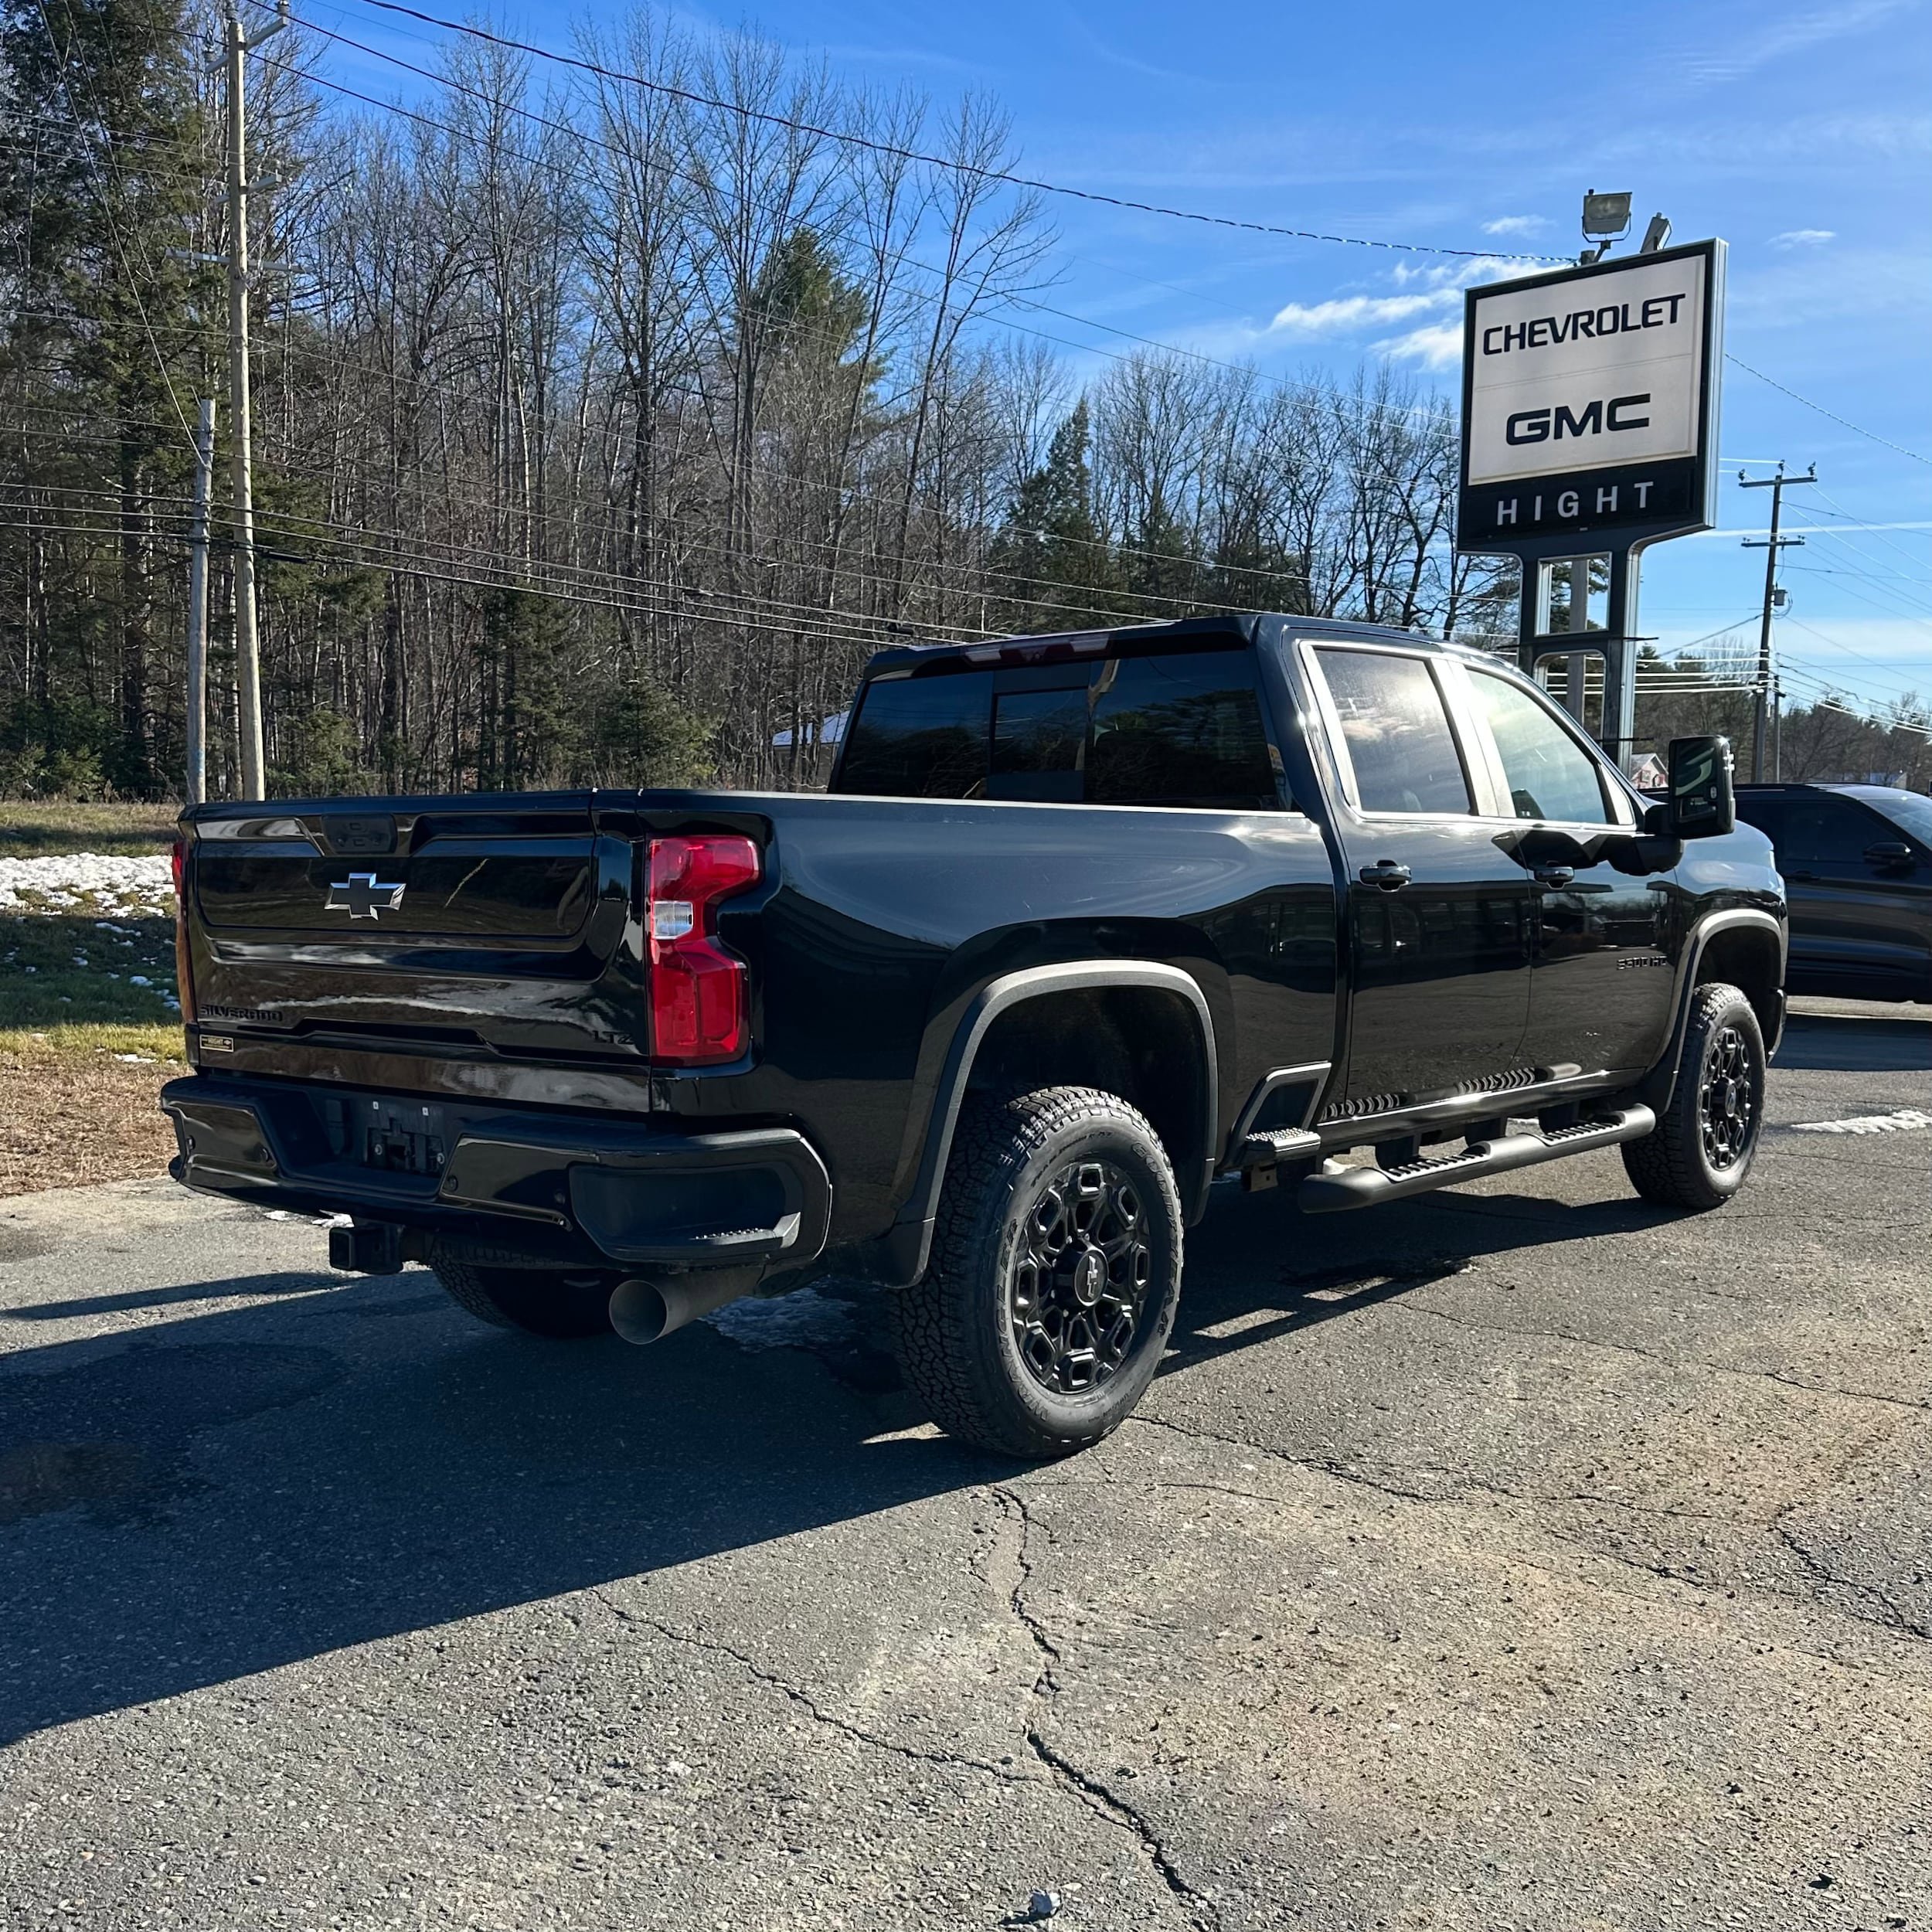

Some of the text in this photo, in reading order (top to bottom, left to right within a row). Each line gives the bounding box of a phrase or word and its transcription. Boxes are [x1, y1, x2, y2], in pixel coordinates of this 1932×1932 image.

[1483, 293, 1685, 355] CHEVROLET
[1506, 393, 1651, 446] GMC
[1497, 481, 1654, 526] HIGHT
[199, 1003, 284, 1022] SILVERADO
[593, 1030, 635, 1044] LTZ
